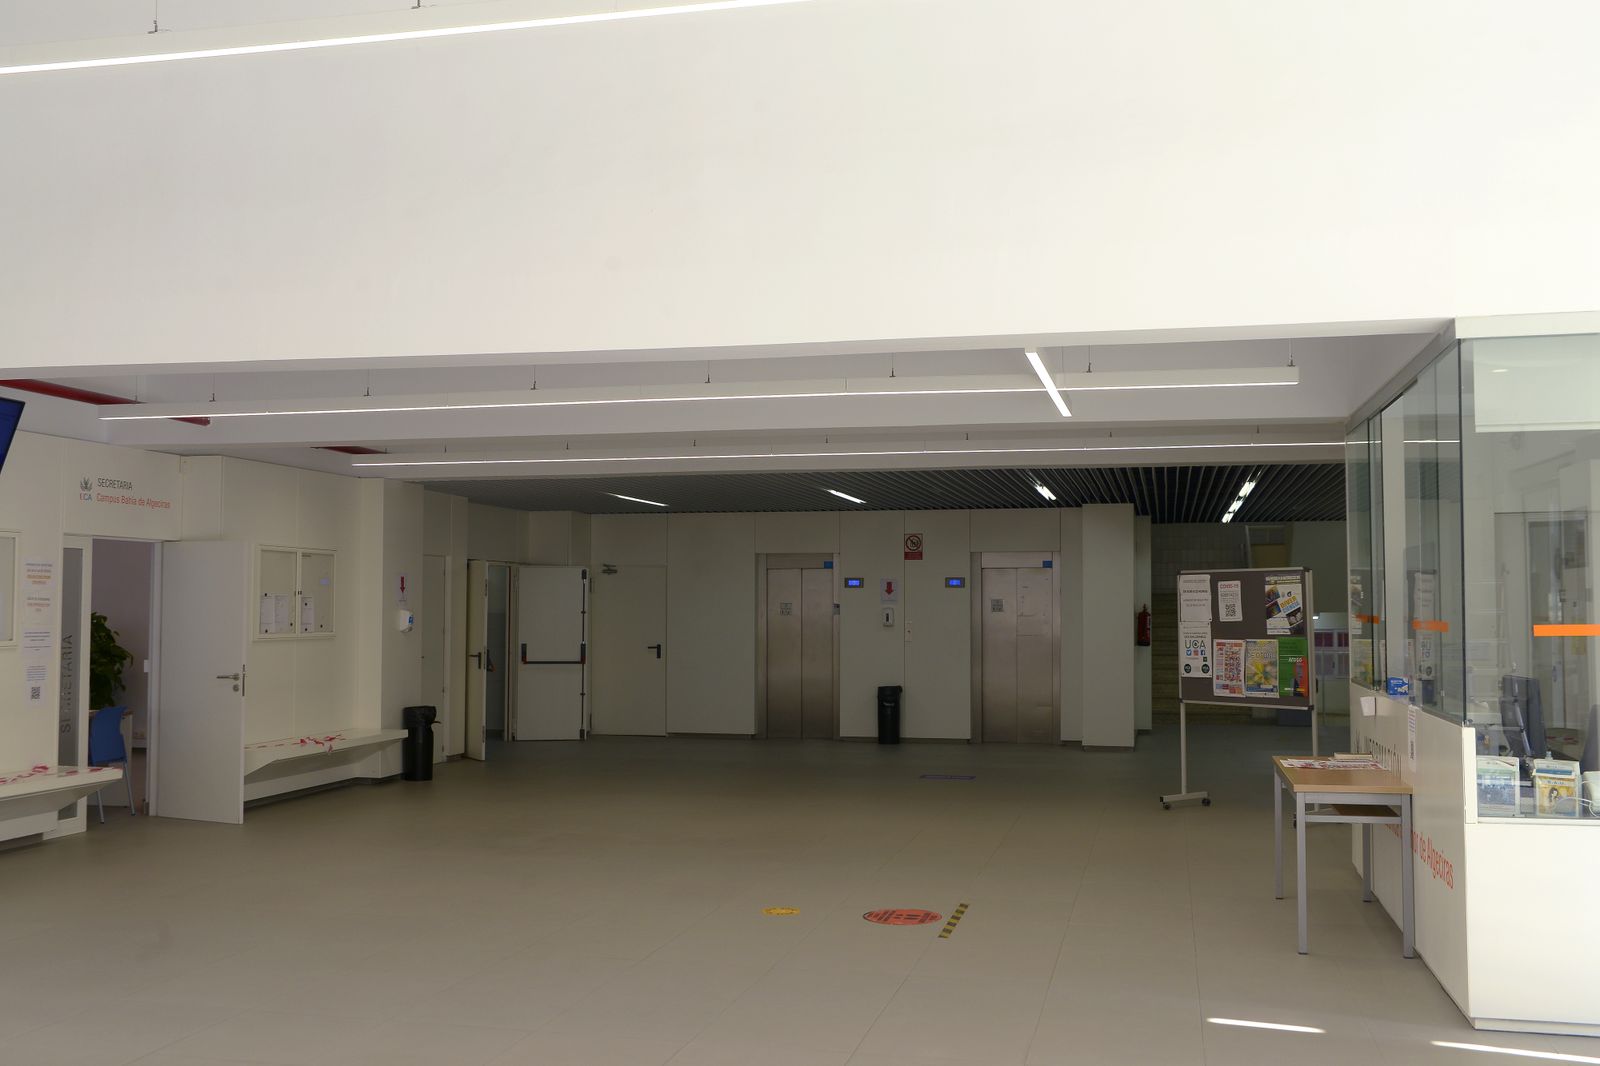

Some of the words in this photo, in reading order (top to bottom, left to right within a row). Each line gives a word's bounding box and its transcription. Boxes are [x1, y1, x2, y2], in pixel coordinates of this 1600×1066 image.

[97, 477, 133, 490] SECRETARIA
[96, 493, 121, 504] Campus
[146, 498, 170, 509] Algeciras
[1185, 639, 1206, 649] UCA
[1427, 835, 1454, 889] Algeciras
